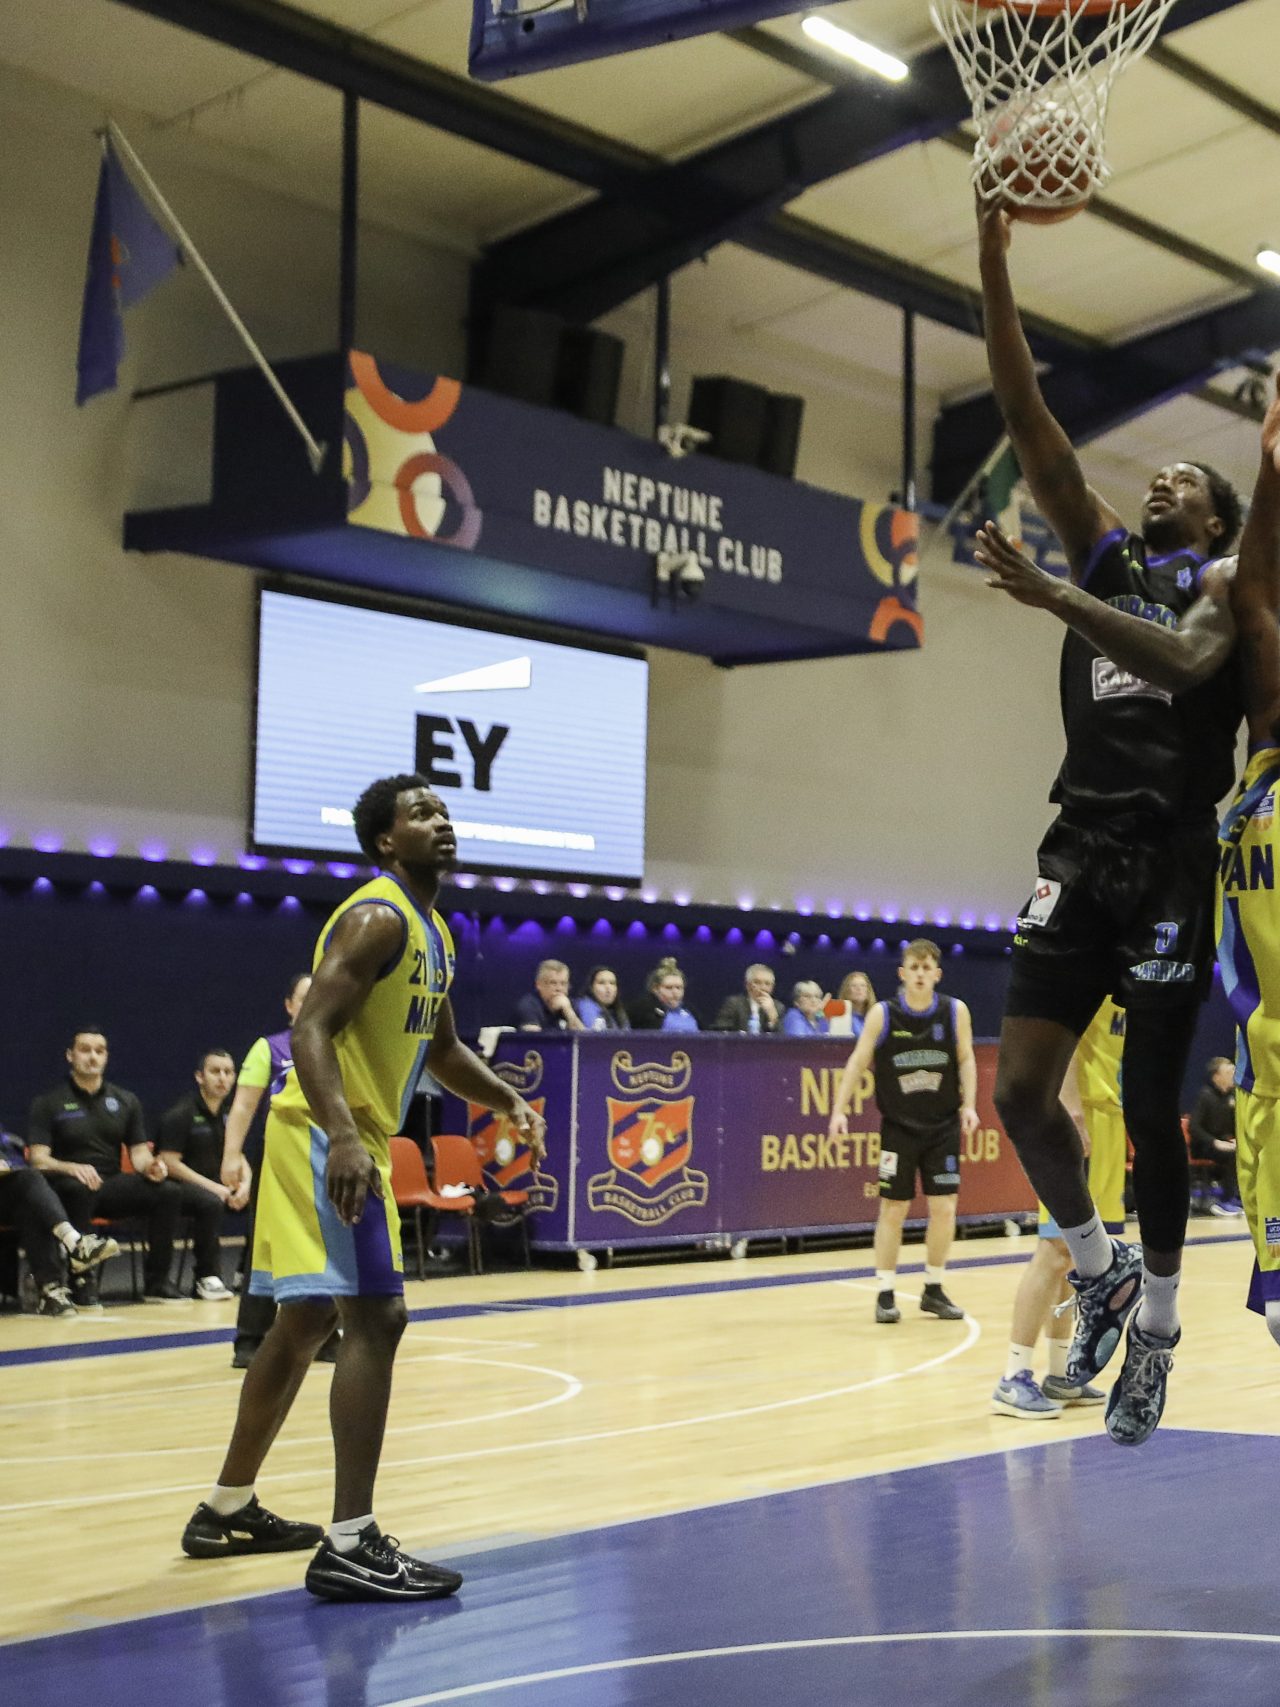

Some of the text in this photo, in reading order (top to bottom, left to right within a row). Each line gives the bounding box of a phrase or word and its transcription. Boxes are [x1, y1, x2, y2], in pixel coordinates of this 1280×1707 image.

[602, 466, 723, 532] NEPTUNE
[533, 488, 783, 584] BASKETBALL CLUB
[415, 711, 509, 791] EY
[408, 948, 427, 985] 21
[761, 1131, 881, 1172] BASKETB
[958, 1128, 1001, 1164] UB
